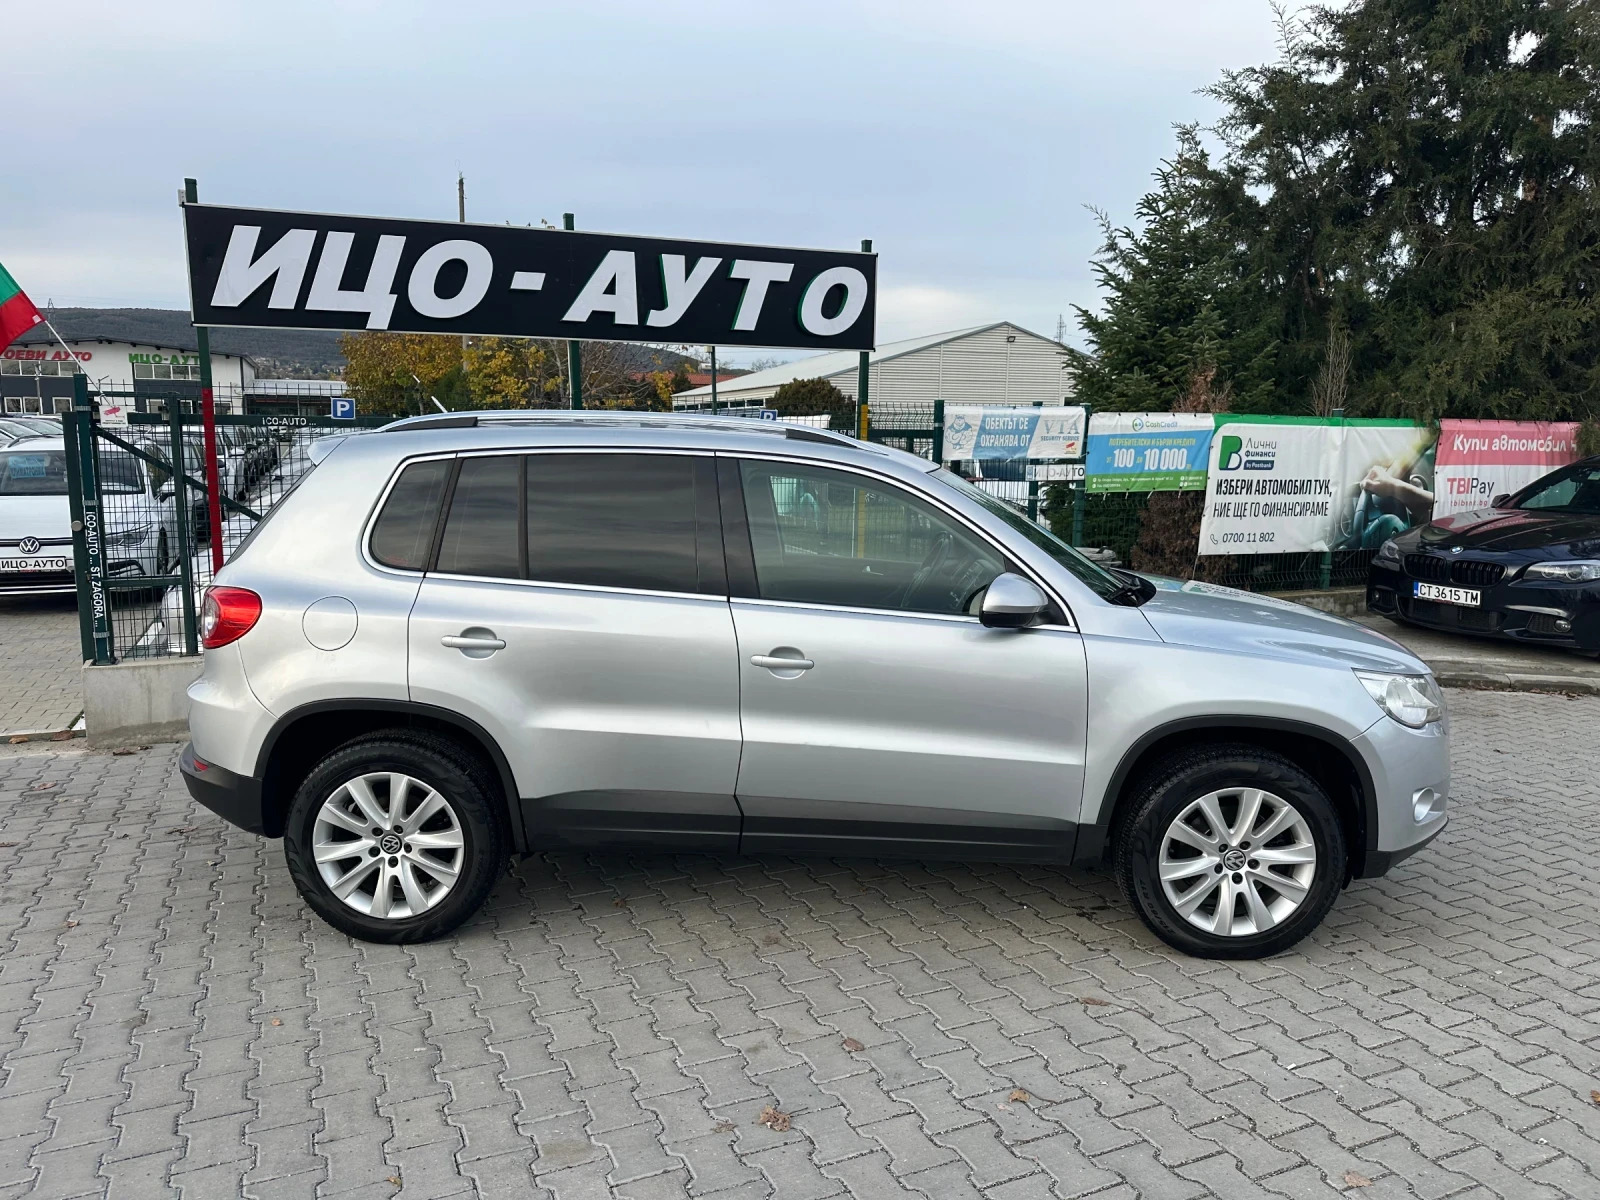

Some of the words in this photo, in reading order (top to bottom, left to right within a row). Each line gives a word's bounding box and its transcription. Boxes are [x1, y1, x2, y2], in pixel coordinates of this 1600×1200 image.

[51, 350, 92, 361] АУТО
[128, 353, 201, 365] ИЦО-АУТ
[336, 401, 350, 416] P
[263, 417, 307, 426] ICO-AUTO
[985, 418, 1017, 430] ОБЕКТЪТ
[1020, 418, 1029, 430] СЕ
[1044, 420, 1080, 434] VTA
[981, 434, 1019, 447] ОХРАНЯВА
[1020, 435, 1030, 447] ОТ
[1245, 438, 1277, 449] Лични
[1453, 434, 1489, 455] Купи
[1491, 434, 1567, 452] автомобил
[1113, 448, 1135, 468] 100
[1215, 479, 1253, 495] ИЗБЕРИ
[1254, 479, 1312, 495] АВТОМОБИЛ
[1313, 479, 1332, 497] ТУК,
[1213, 502, 1231, 518] НИЕ
[1233, 502, 1248, 520] ЩЕ
[1249, 502, 1260, 517] ГО
[1261, 501, 1329, 517] ФИНАНСИРАМЕ
[1222, 532, 1245, 543] 0700
[1246, 532, 1257, 542] 11
[1258, 532, 1275, 542] 802
[1, 559, 65, 569] ИЦО-АУТО
[85, 511, 98, 555] ICO-AUTO
[92, 581, 104, 619] ZAGORA
[1434, 586, 1461, 601] 3615
